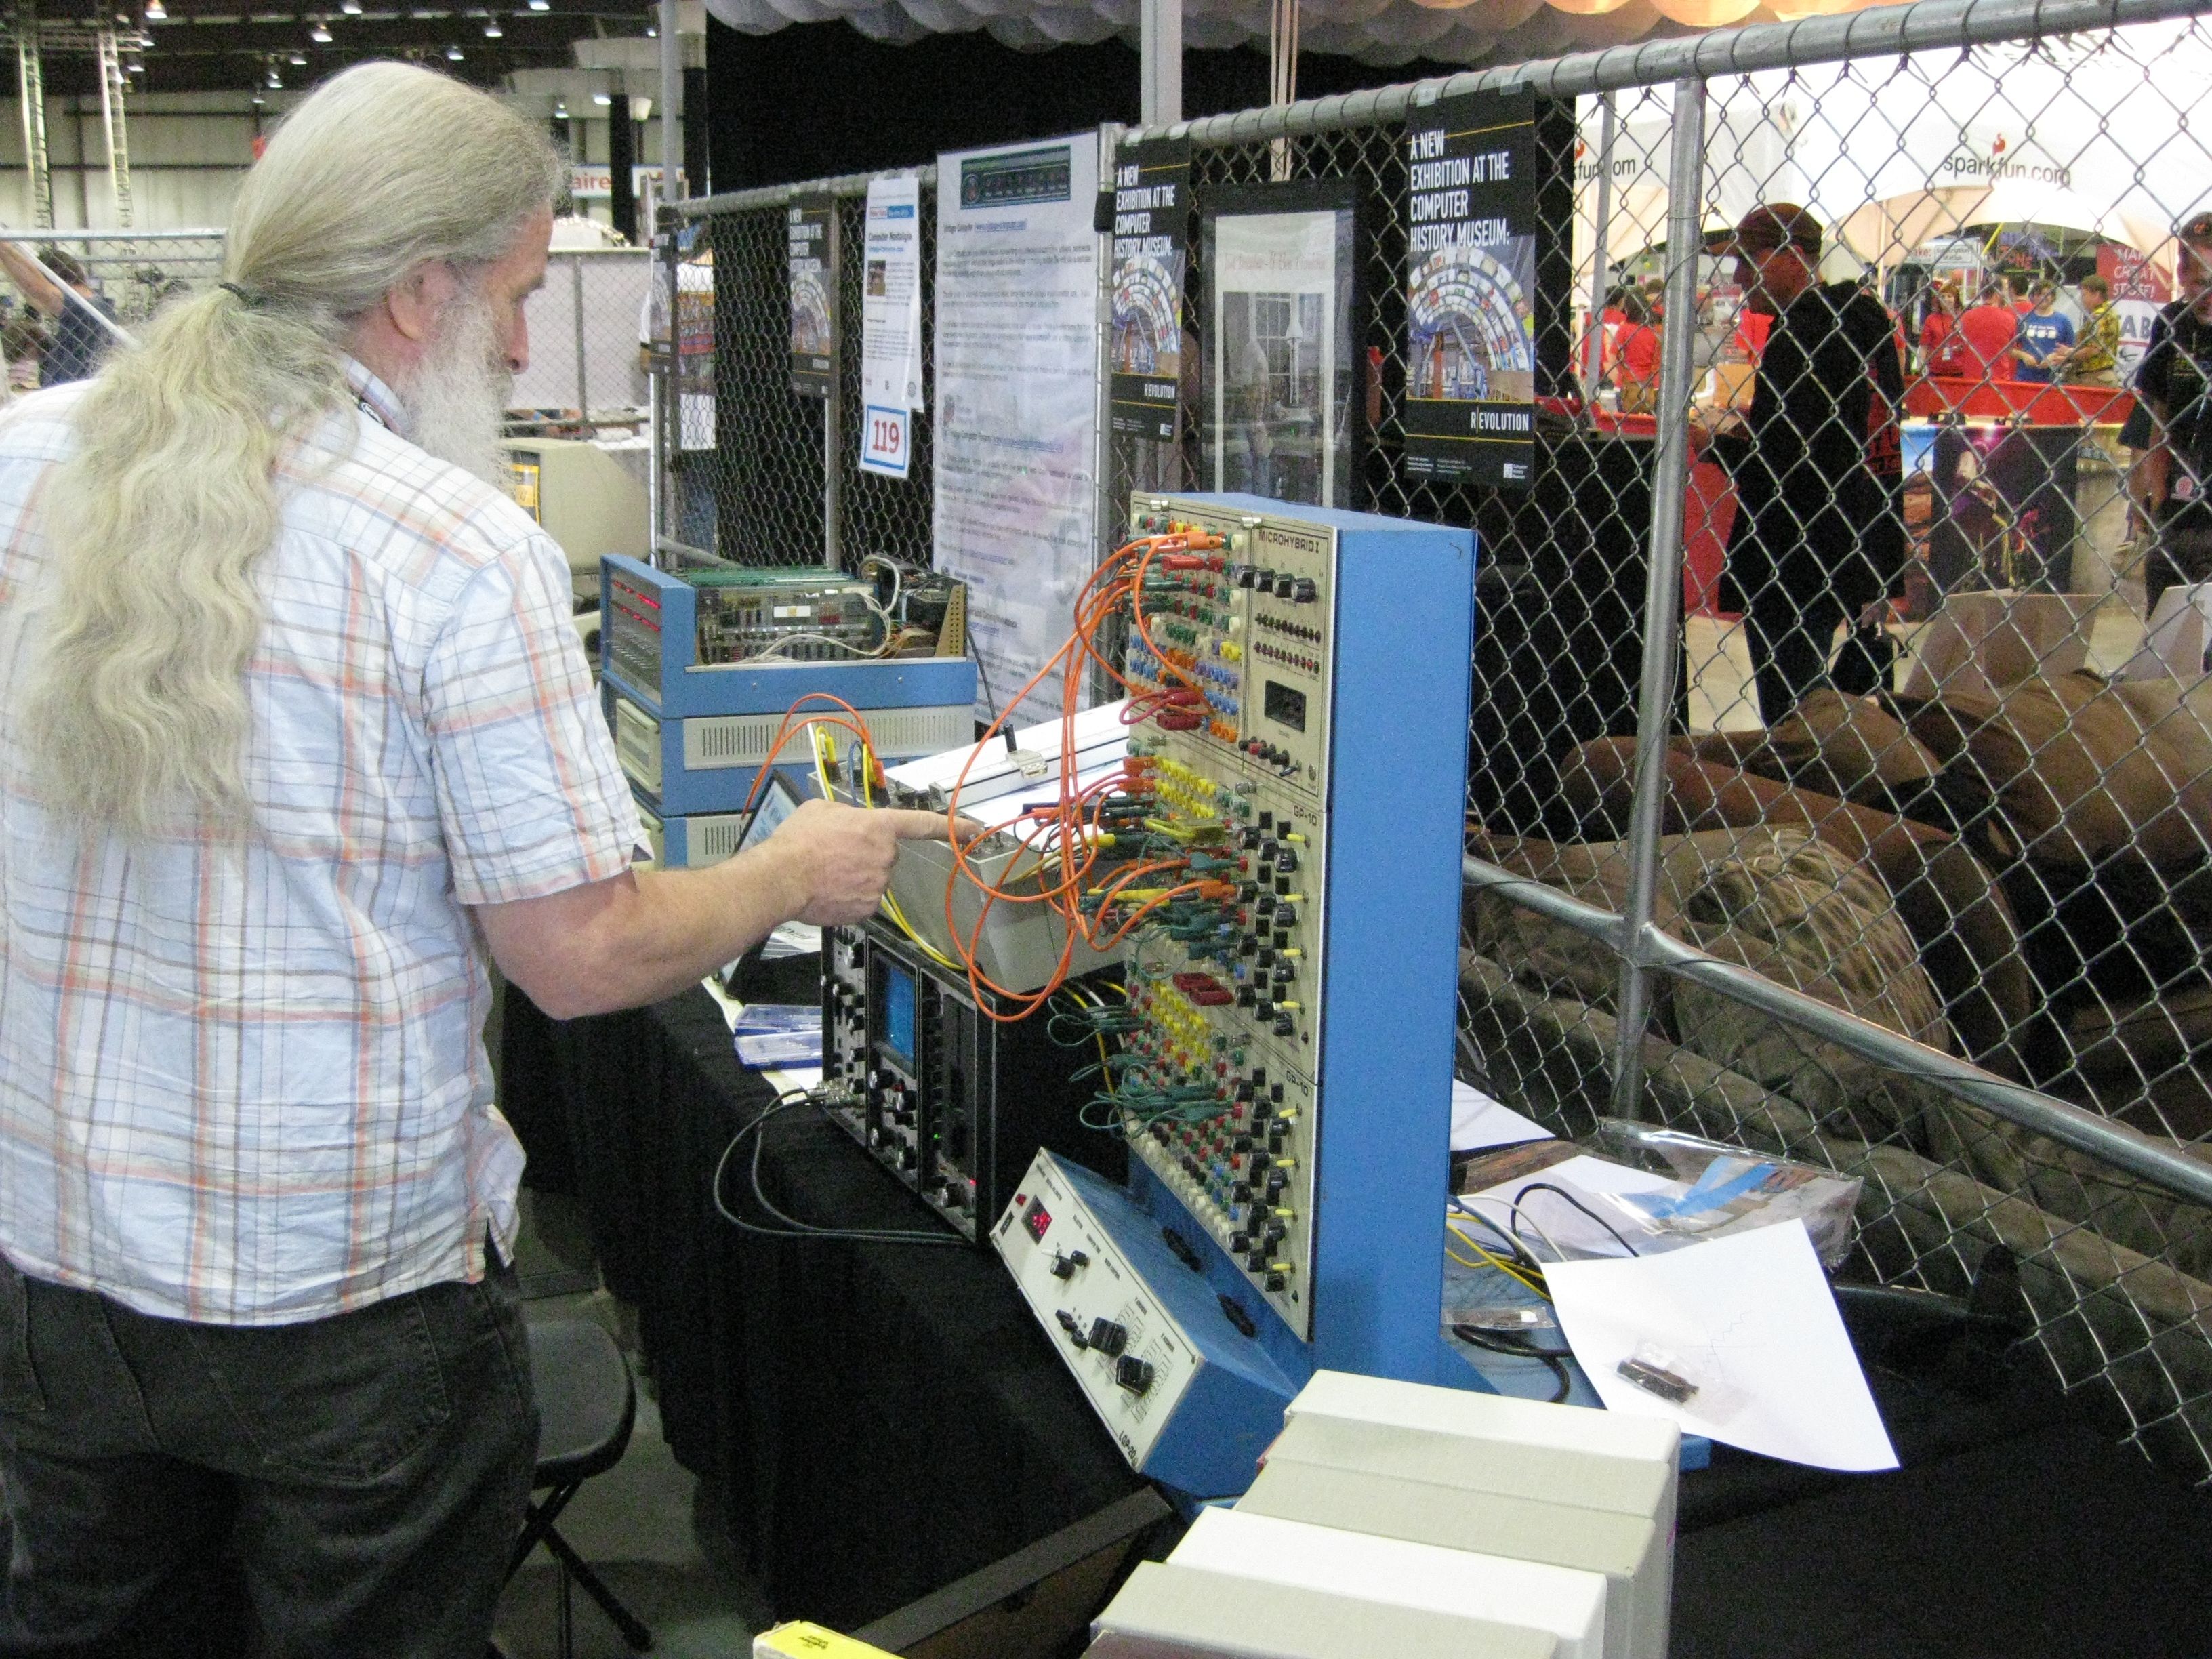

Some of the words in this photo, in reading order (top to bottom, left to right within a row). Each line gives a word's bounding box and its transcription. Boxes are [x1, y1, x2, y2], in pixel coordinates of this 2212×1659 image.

[1410, 135, 1418, 161] A
[1420, 129, 1444, 159] NEW
[1124, 165, 1139, 186] NEW
[1411, 158, 1469, 191] EXHIBITION
[1473, 155, 1486, 183] AT
[1488, 152, 1509, 181] THE
[1116, 188, 1151, 211] EXHIBITION
[1153, 186, 1160, 207] AT
[1162, 185, 1175, 206] THE
[1410, 190, 1469, 222] COMPUTER
[1115, 213, 1151, 234] COMPUTER
[1410, 223, 1454, 252] HISTORY
[1458, 218, 1510, 248] MUSEUM:
[1114, 238, 1141, 258] HISTORY
[872, 419, 899, 453] 119
[1259, 530, 1313, 553] MICROHYBRID
[1294, 805, 1317, 826] GP-10
[1286, 1070, 1309, 1097] GP-10
